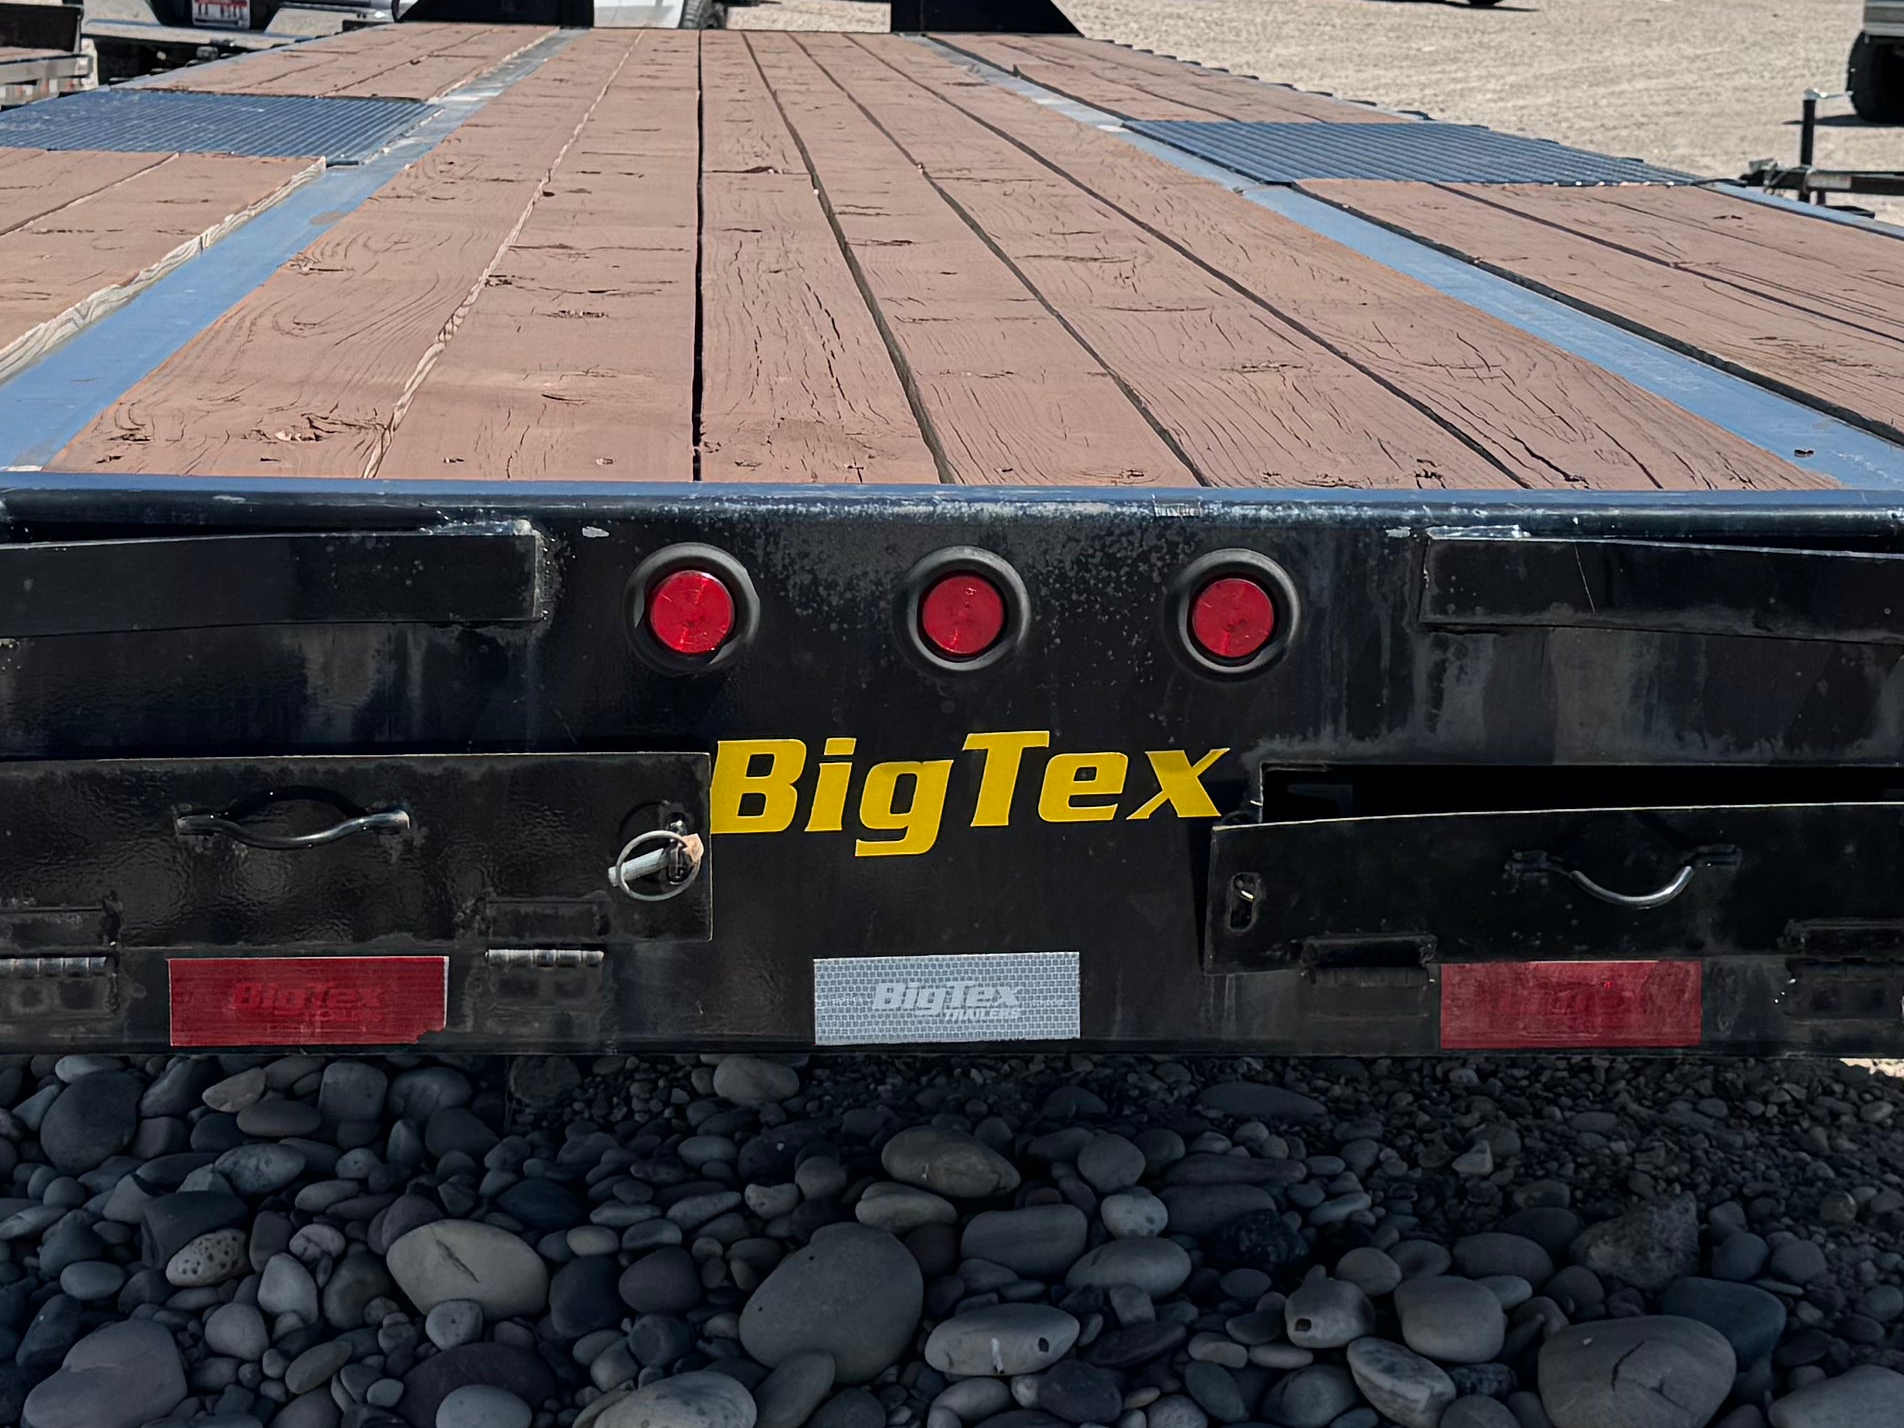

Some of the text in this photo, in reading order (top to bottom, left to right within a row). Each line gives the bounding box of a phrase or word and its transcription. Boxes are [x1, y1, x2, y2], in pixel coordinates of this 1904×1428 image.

[709, 730, 1231, 857] BigTex
[871, 981, 1020, 1016] BigTex
[944, 1009, 1022, 1022] TRAILERS
